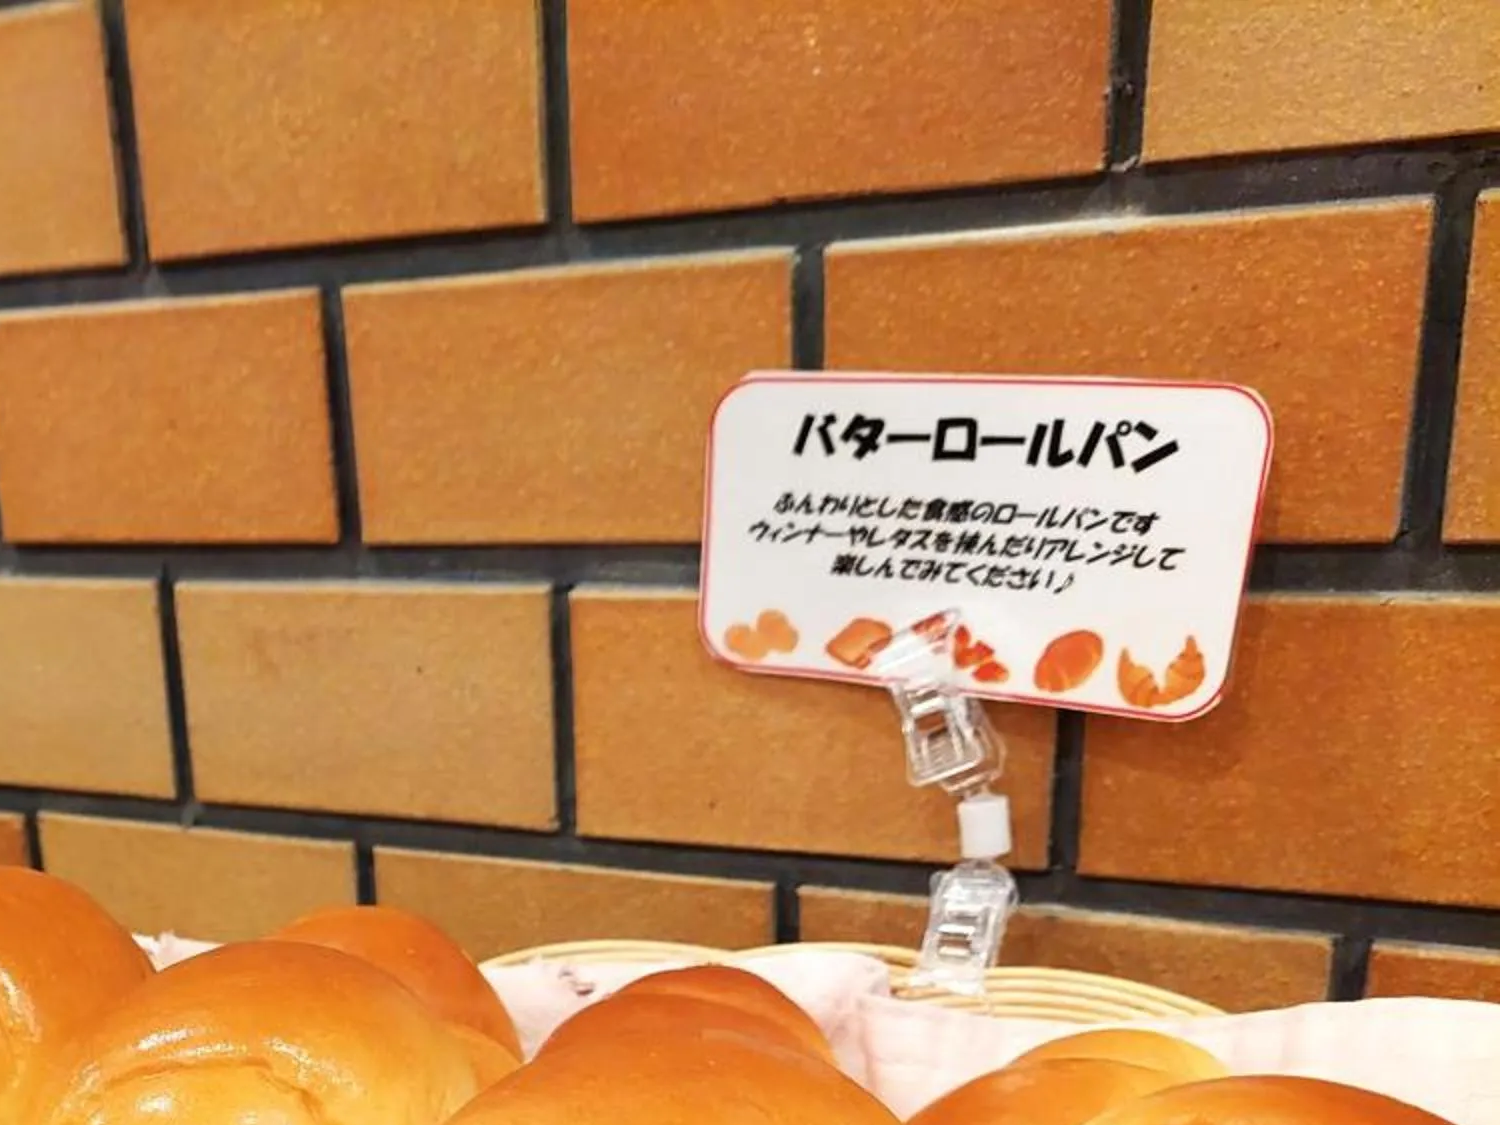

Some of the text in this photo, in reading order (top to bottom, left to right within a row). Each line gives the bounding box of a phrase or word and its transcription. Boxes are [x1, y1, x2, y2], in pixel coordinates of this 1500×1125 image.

[792, 412, 1180, 474] バターロールパン
